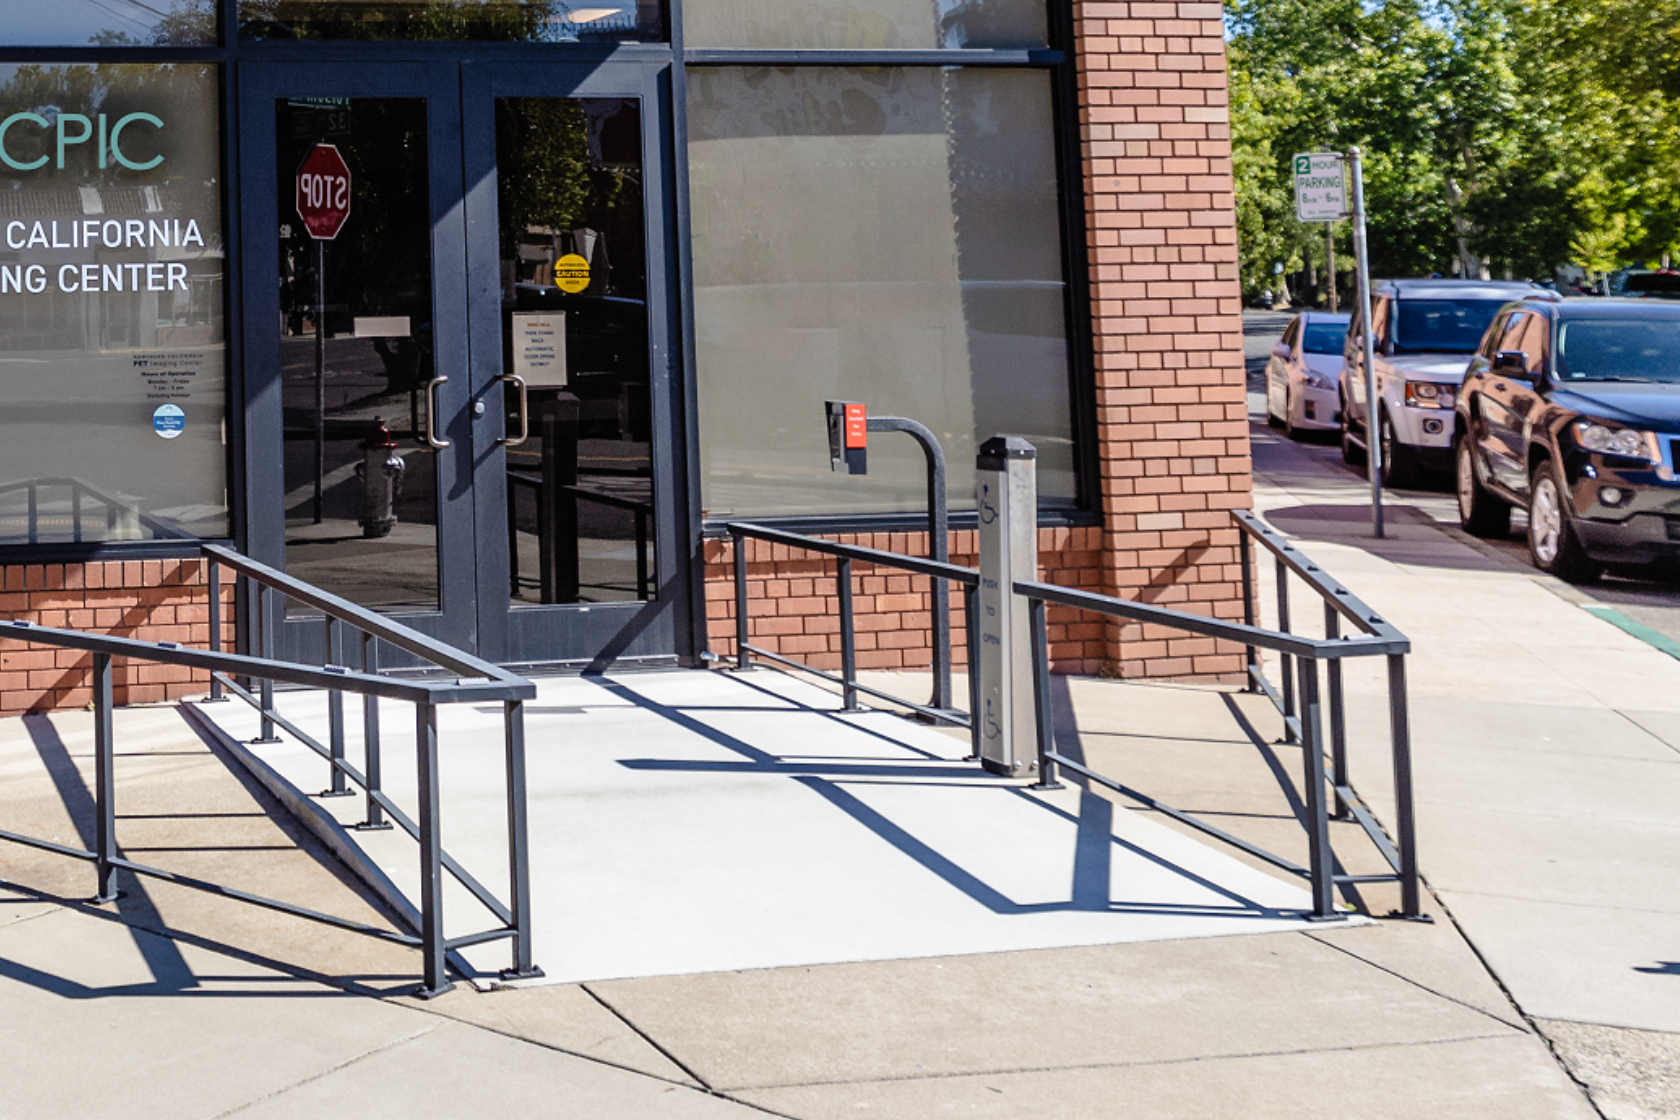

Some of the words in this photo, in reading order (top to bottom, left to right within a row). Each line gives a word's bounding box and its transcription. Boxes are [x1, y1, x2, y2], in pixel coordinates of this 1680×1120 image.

[1298, 159, 1308, 173] 2
[1312, 161, 1339, 169] HOUR
[1299, 176, 1341, 188] PARKING
[6, 219, 205, 249] CALIFORNIA
[58, 263, 189, 293] CENTER
